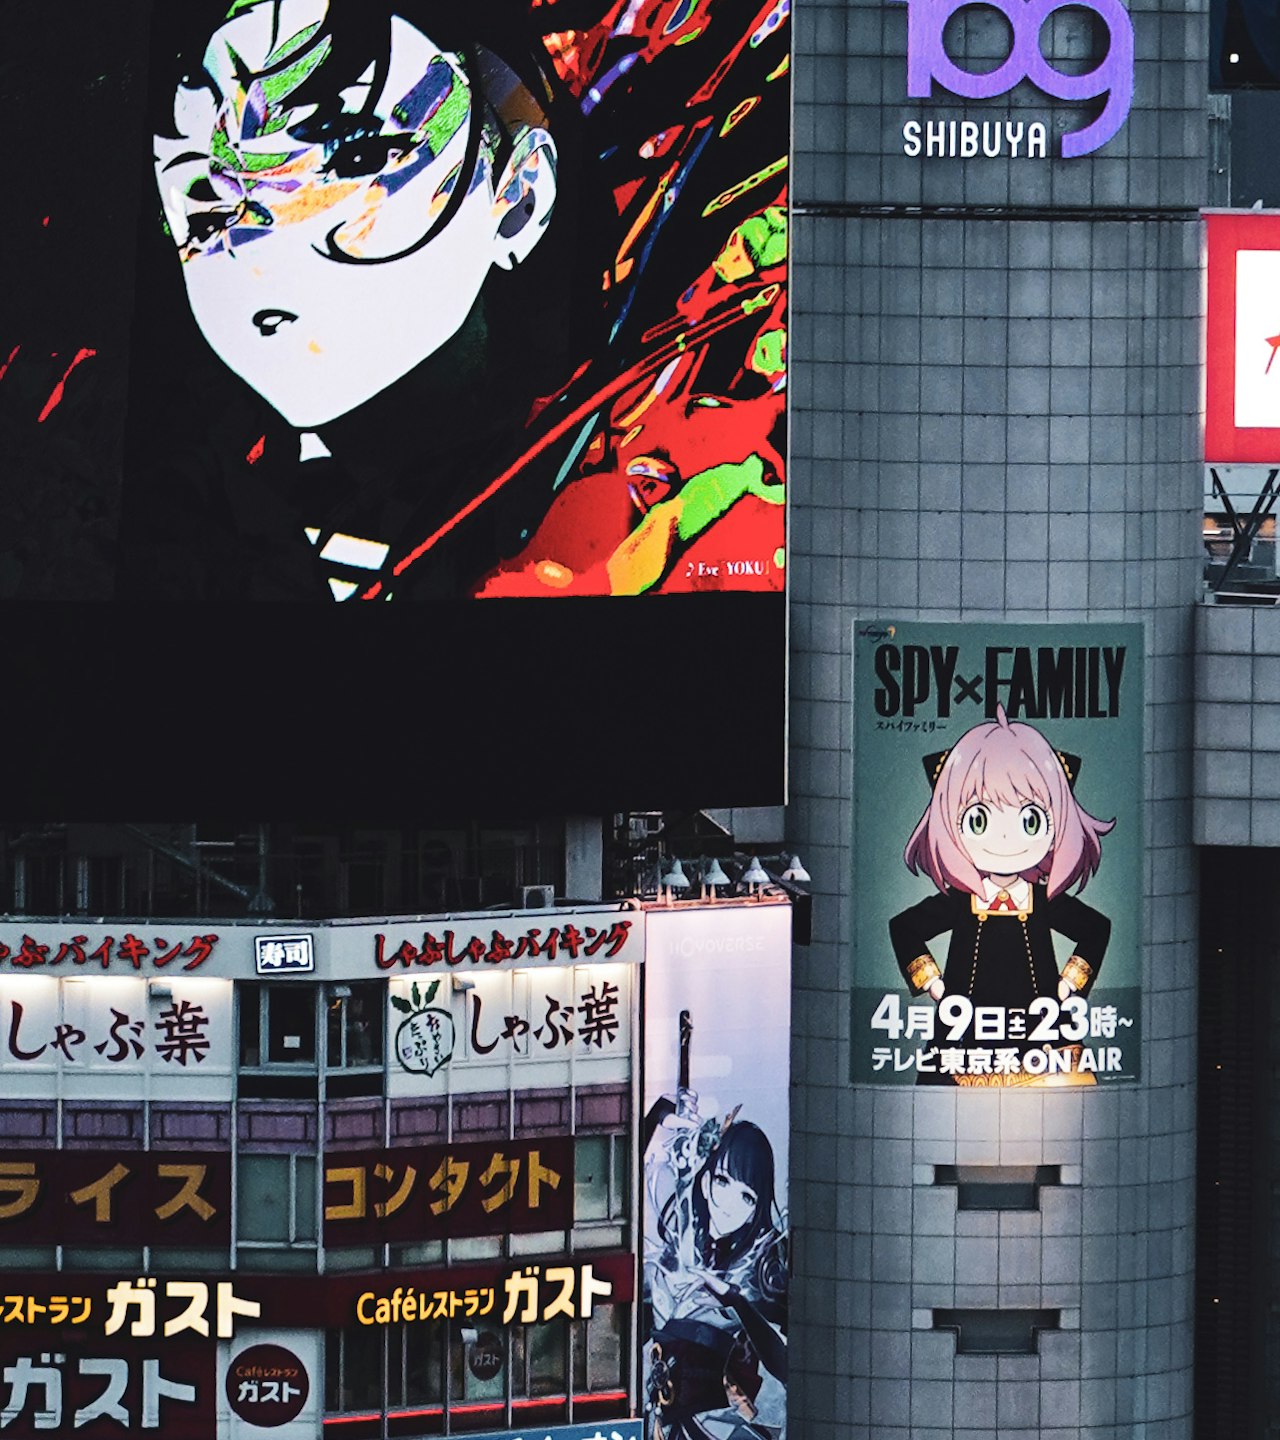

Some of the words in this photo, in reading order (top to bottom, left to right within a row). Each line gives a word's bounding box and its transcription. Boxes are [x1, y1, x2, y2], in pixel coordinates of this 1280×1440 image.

[903, 120, 1047, 159] SHIBUYA
[876, 721, 948, 734] スパイファミリー
[260, 940, 310, 970] 寿司
[374, 920, 631, 970] しゃぶしゃぶバイキング
[6, 998, 212, 1067] しゃぶ葉
[469, 979, 620, 1055] しゃぶ葉
[870, 1048, 1020, 1075] テレビ東京系
[1022, 1047, 1071, 1073] ON
[1077, 1047, 1123, 1073] AIR
[325, 1150, 563, 1222] コンタクト
[103, 1277, 262, 1339] ガスト
[502, 1263, 613, 1325] ガスト
[0, 1354, 197, 1430] ガスト
[236, 1379, 301, 1405] ガスト
